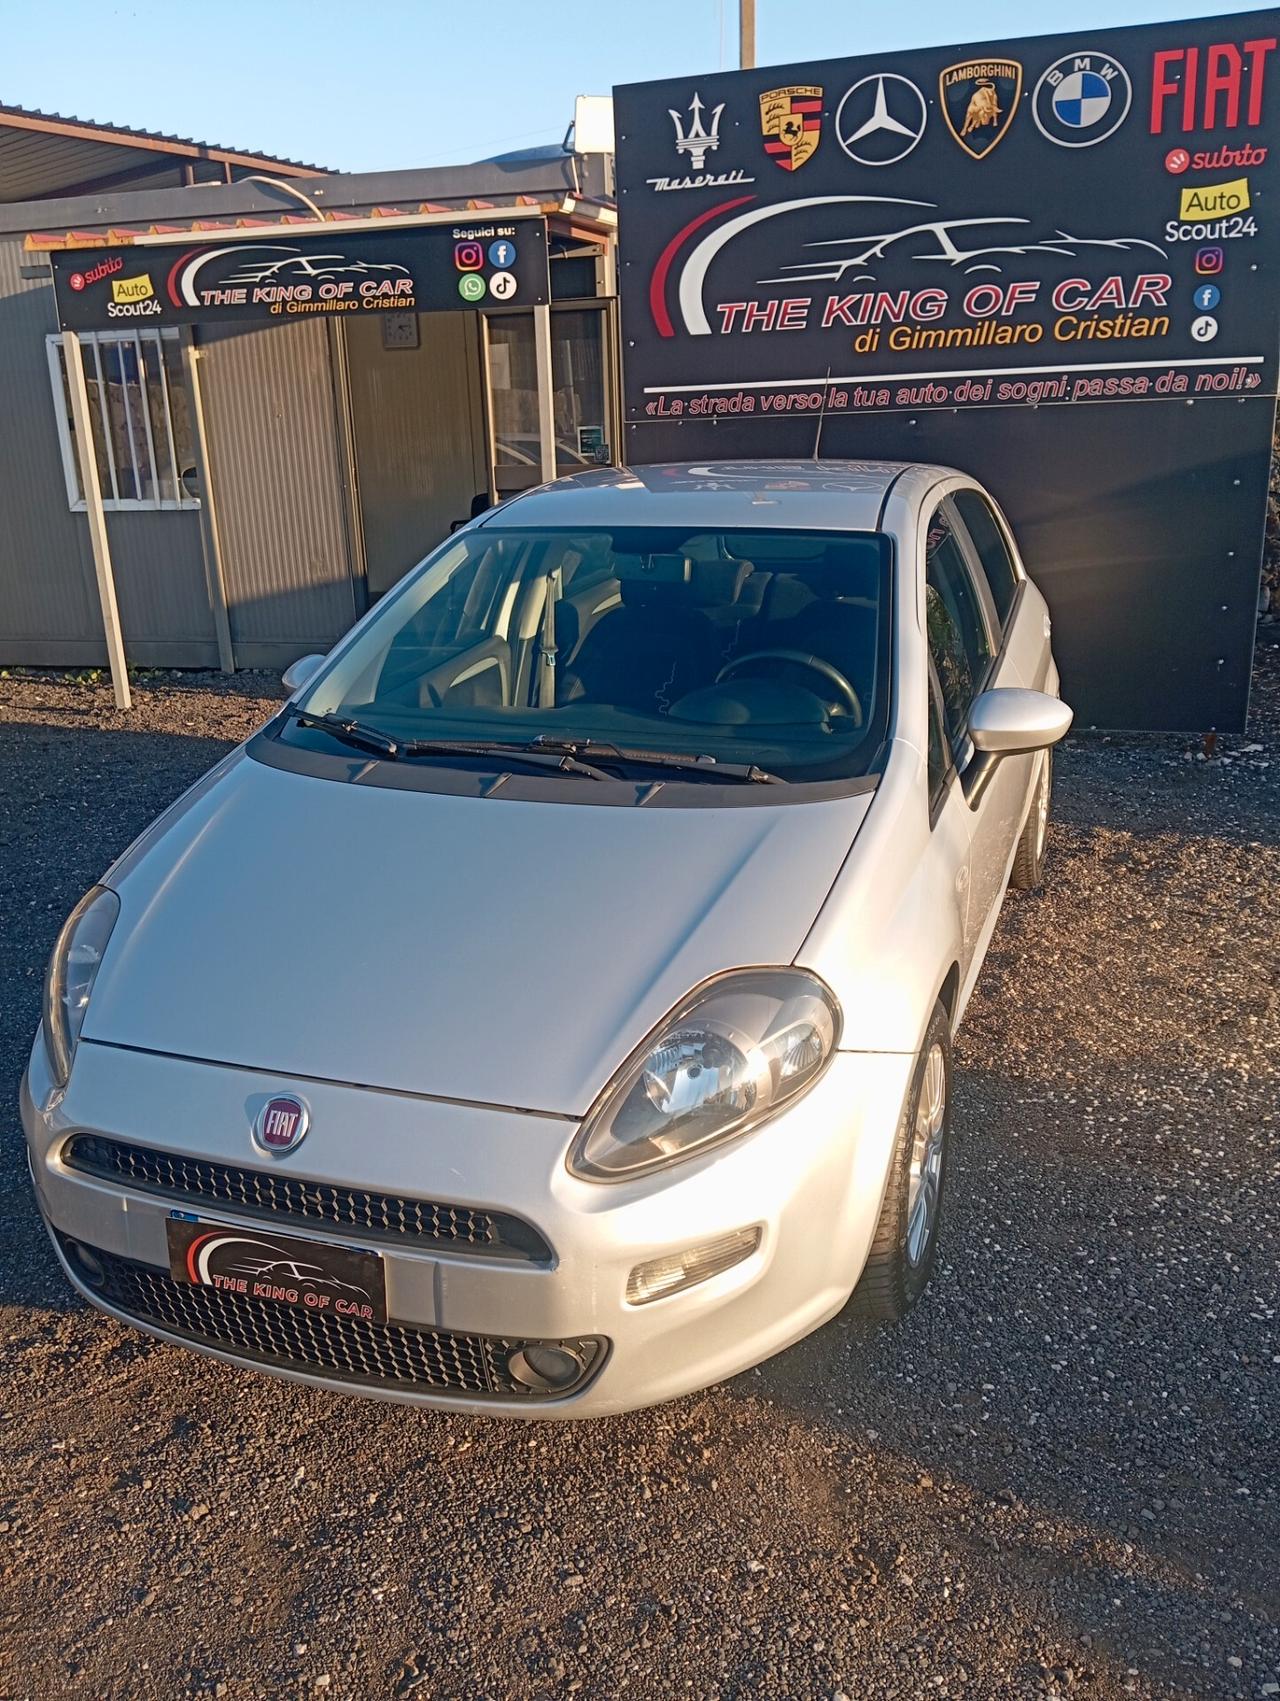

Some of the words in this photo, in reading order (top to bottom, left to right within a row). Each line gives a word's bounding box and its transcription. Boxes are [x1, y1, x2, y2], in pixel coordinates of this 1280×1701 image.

[945, 64, 1016, 86] LAMBORGHINI
[1046, 57, 1119, 87] BMW
[760, 86, 823, 103] PORSCHE
[1150, 38, 1277, 134] FIAT
[1191, 144, 1268, 170] subito
[646, 169, 755, 192] Maserati
[1185, 191, 1241, 213] Auto
[452, 227, 495, 240] Seguici
[497, 226, 516, 237] su:
[1164, 216, 1258, 242] Scout24
[83, 256, 124, 285] subito
[116, 282, 149, 298] Auto
[200, 288, 247, 306] THE
[252, 282, 313, 303] KING
[318, 281, 354, 300] OF
[358, 278, 414, 297] CAR
[107, 300, 162, 318] Scout24
[270, 302, 283, 315] di
[284, 299, 358, 314] Gimmillaro
[362, 295, 416, 310] Cristian
[717, 298, 811, 334] THE
[821, 288, 949, 328] KING
[963, 281, 1041, 318] OF
[1051, 273, 1172, 312] CAR
[854, 326, 879, 353] di
[888, 319, 1043, 351] Gimmillaro
[1053, 312, 1170, 342] Cristian
[688, 392, 755, 415] strada
[761, 391, 823, 412] verso
[828, 387, 849, 408] la
[854, 386, 890, 406] tua
[895, 383, 948, 405] auto
[954, 379, 993, 401] dei
[997, 375, 1069, 405] sogni
[1072, 373, 1150, 400] passa
[1155, 371, 1188, 393] da
[266, 1110, 298, 1137] FIAT
[211, 1274, 247, 1293] THE
[253, 1282, 298, 1303] KING
[304, 1292, 331, 1309] OF
[335, 1299, 374, 1320] CAR
